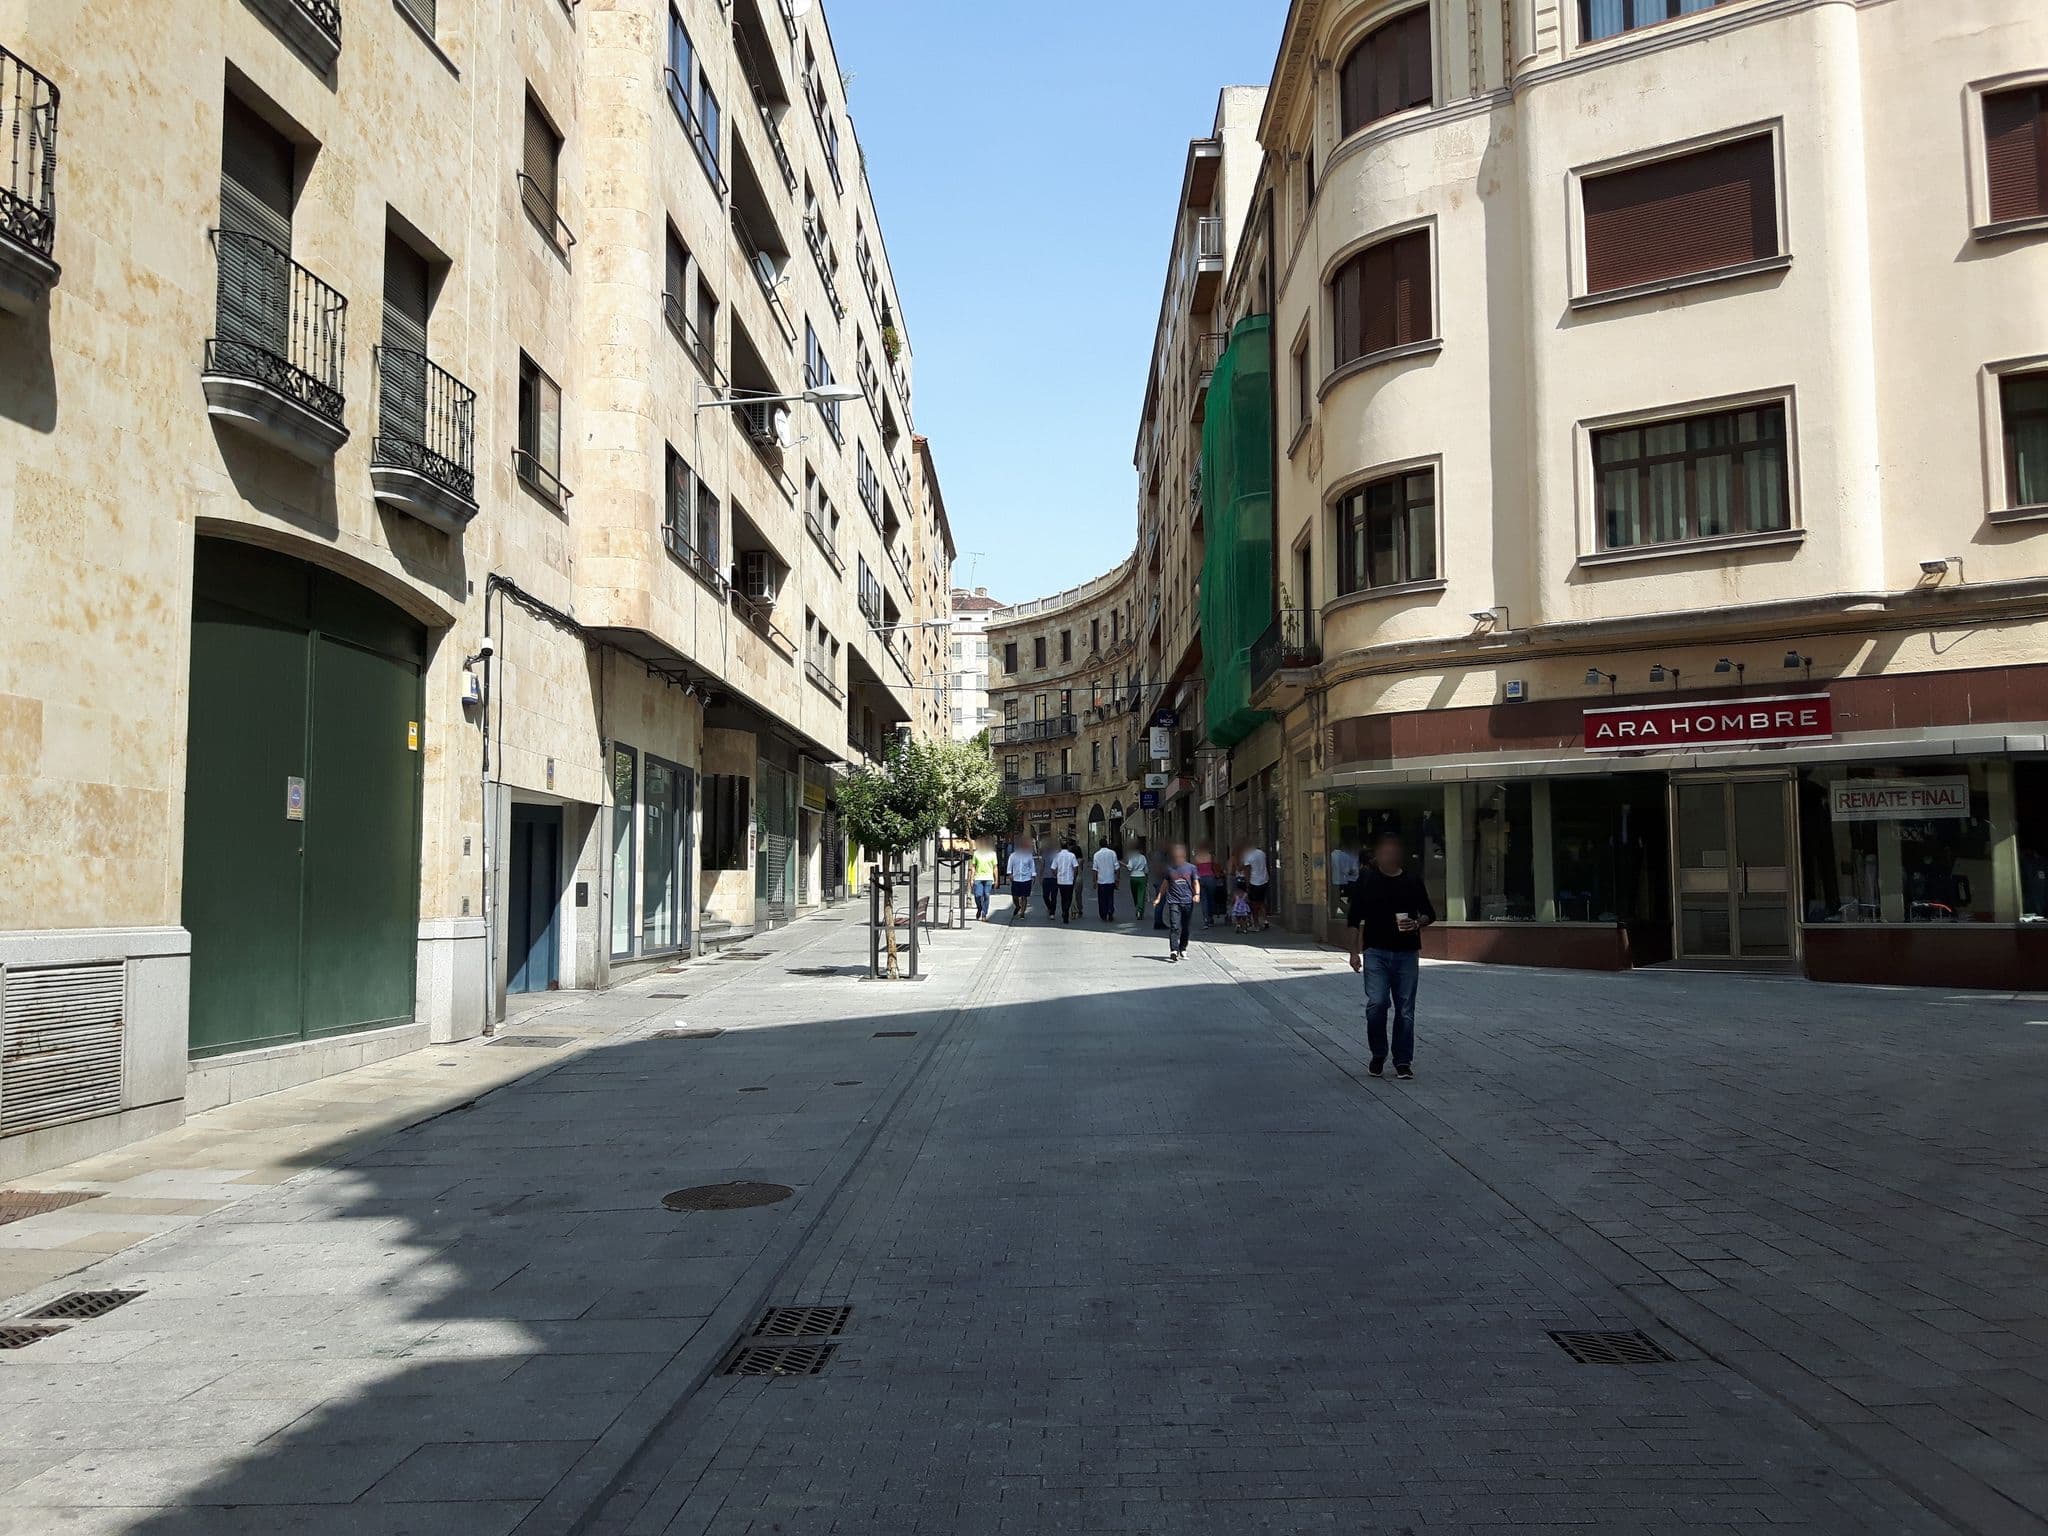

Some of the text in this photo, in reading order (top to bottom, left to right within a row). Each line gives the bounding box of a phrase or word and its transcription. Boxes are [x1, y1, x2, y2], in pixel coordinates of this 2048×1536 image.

[1596, 709, 1818, 738] ARA HOMBRE
[1838, 789, 1962, 809] REMATE FINAL
